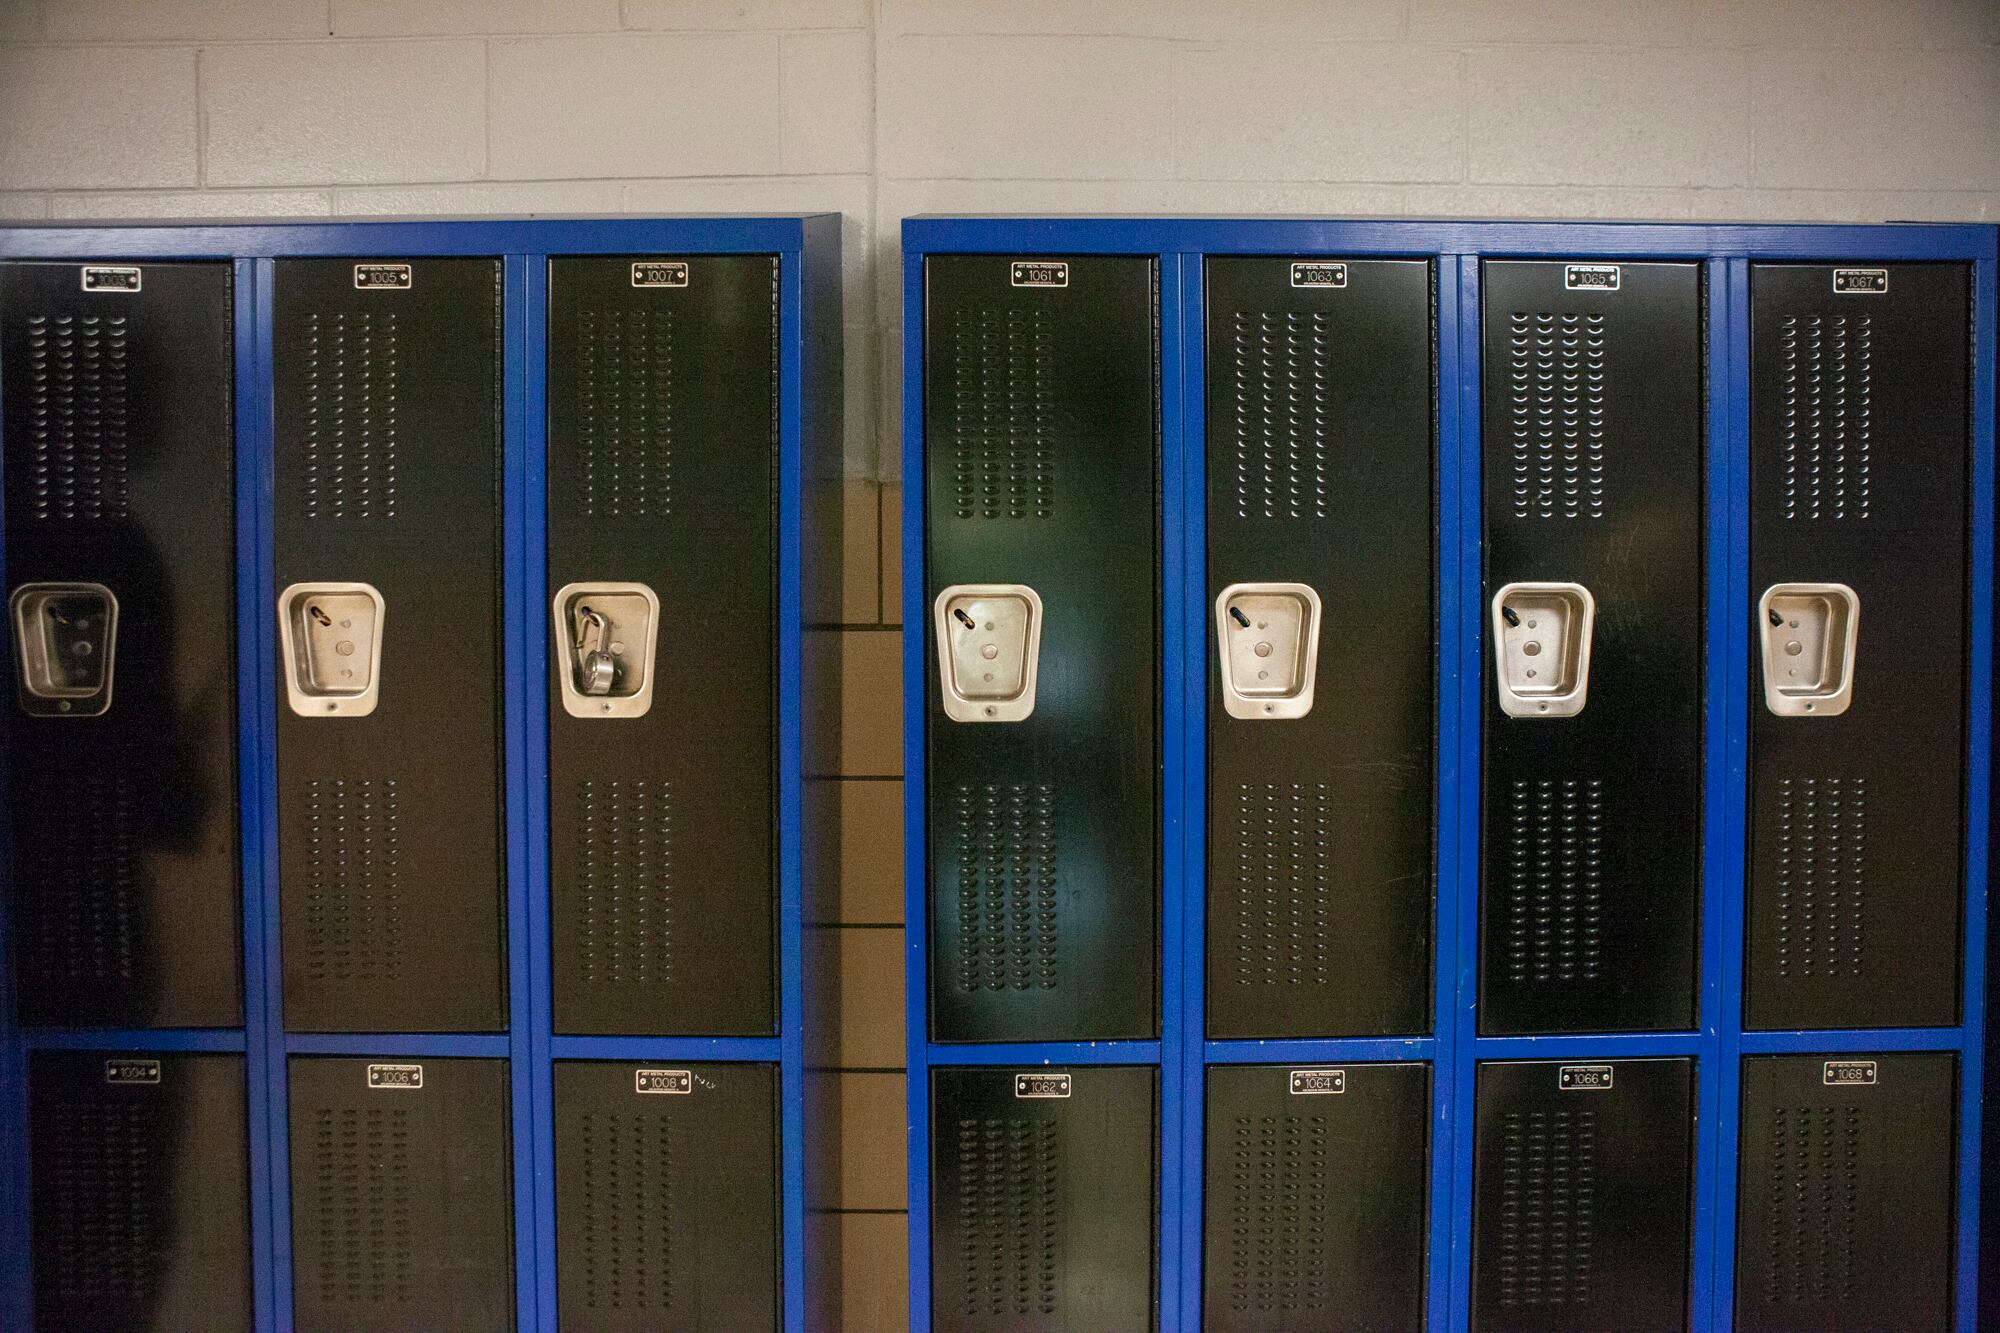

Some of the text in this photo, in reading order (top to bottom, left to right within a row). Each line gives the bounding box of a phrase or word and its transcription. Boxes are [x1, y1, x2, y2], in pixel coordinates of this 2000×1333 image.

[370, 272, 397, 283] 1005
[648, 270, 673, 281] 1007
[1029, 270, 1052, 281] 1061
[1307, 271, 1332, 282] 1063
[1581, 273, 1606, 284] 1065
[1849, 276, 1873, 287] 1067
[383, 1072, 408, 1082] 1006
[1574, 1073, 1599, 1084] 1066
[1839, 1068, 1862, 1079] 1068
[652, 1077, 676, 1088] 1008
[1031, 1081, 1056, 1092] 1062
[1306, 1078, 1331, 1089] 1064
